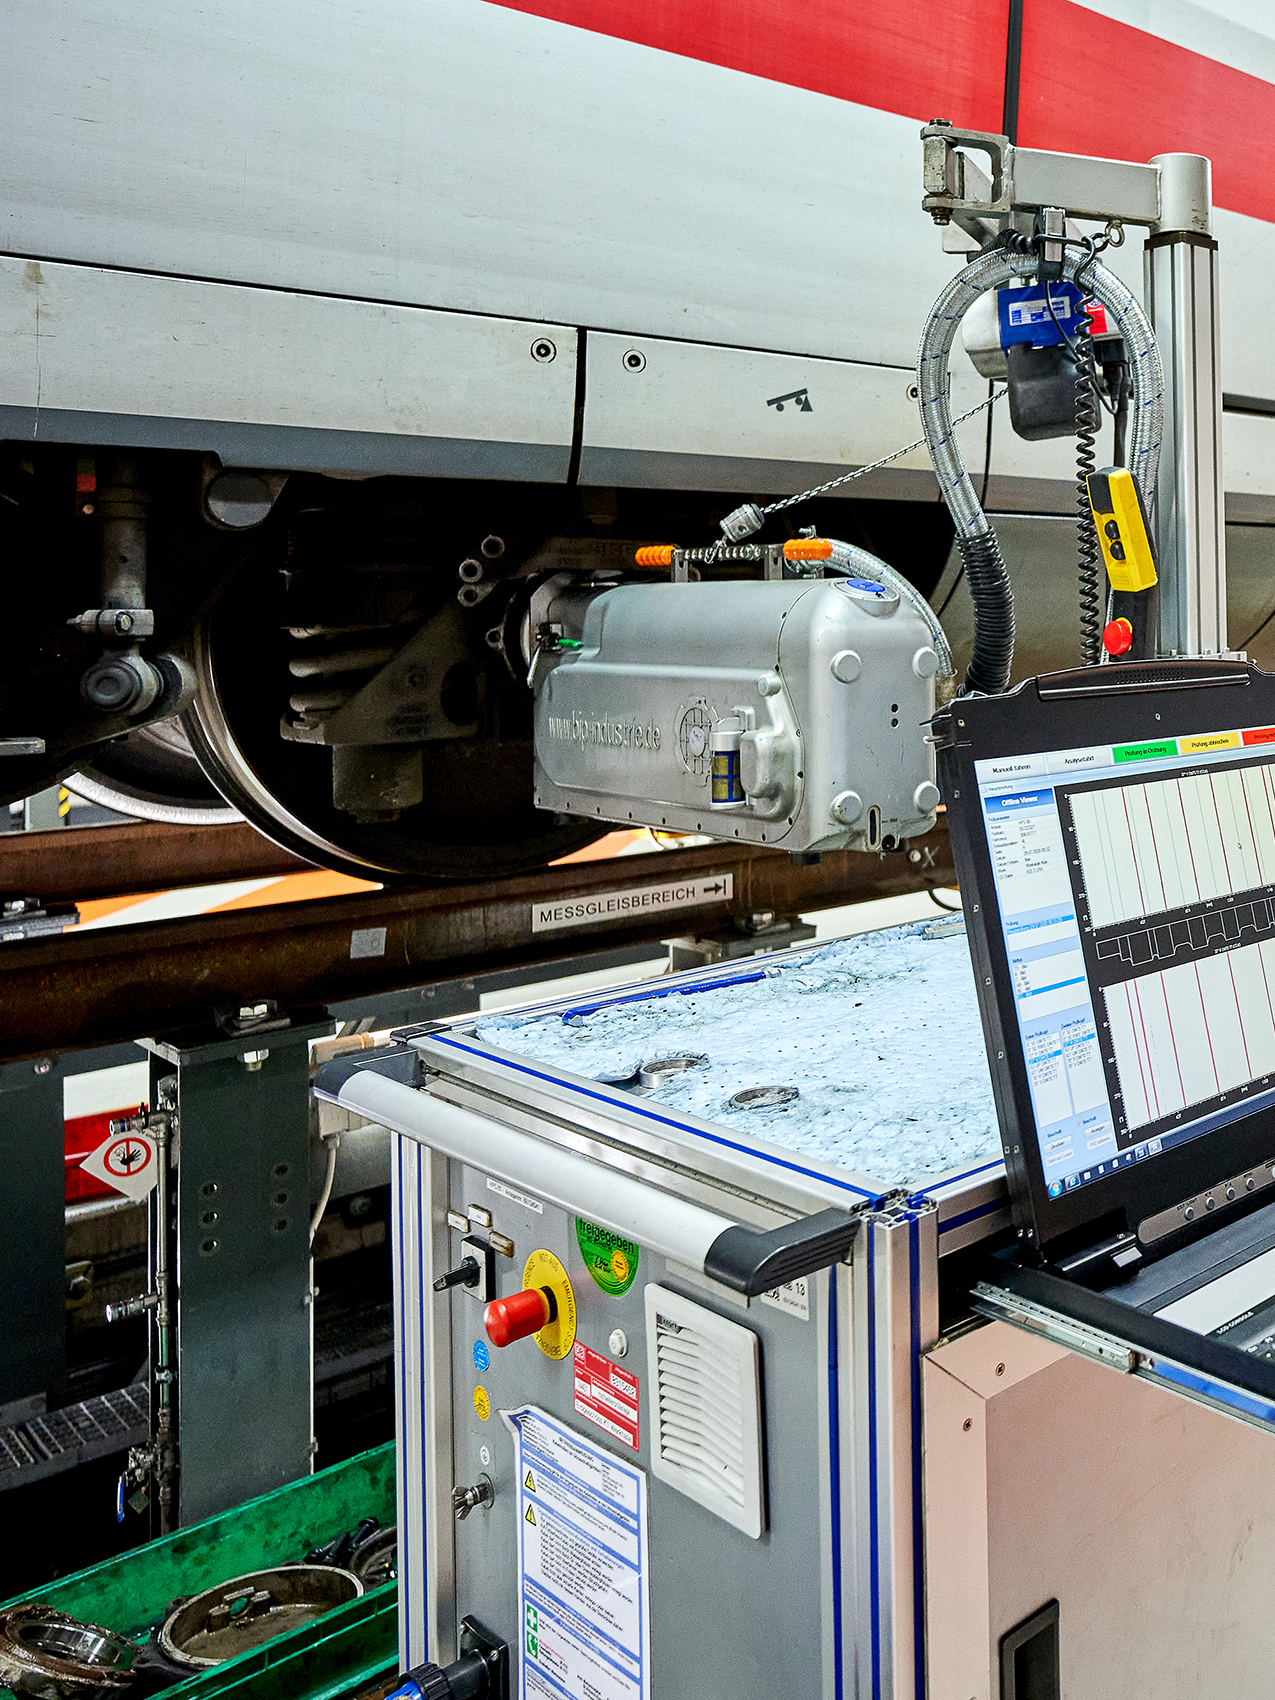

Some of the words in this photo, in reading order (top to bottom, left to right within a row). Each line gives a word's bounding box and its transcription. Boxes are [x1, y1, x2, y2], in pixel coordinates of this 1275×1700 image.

[1191, 740, 1208, 749] Prüfung
[1124, 747, 1143, 757] Prüfung
[1148, 746, 1167, 756] Ordnung
[1064, 755, 1095, 765] Analysefahrt
[992, 766, 1013, 774] Manuell
[1013, 764, 1032, 772] fahren
[1020, 796, 1038, 804] Viewer
[540, 886, 695, 924] MESSGLEISBEREICH
[579, 1217, 634, 1254] freigegeben
[795, 1282, 806, 1296] 13
